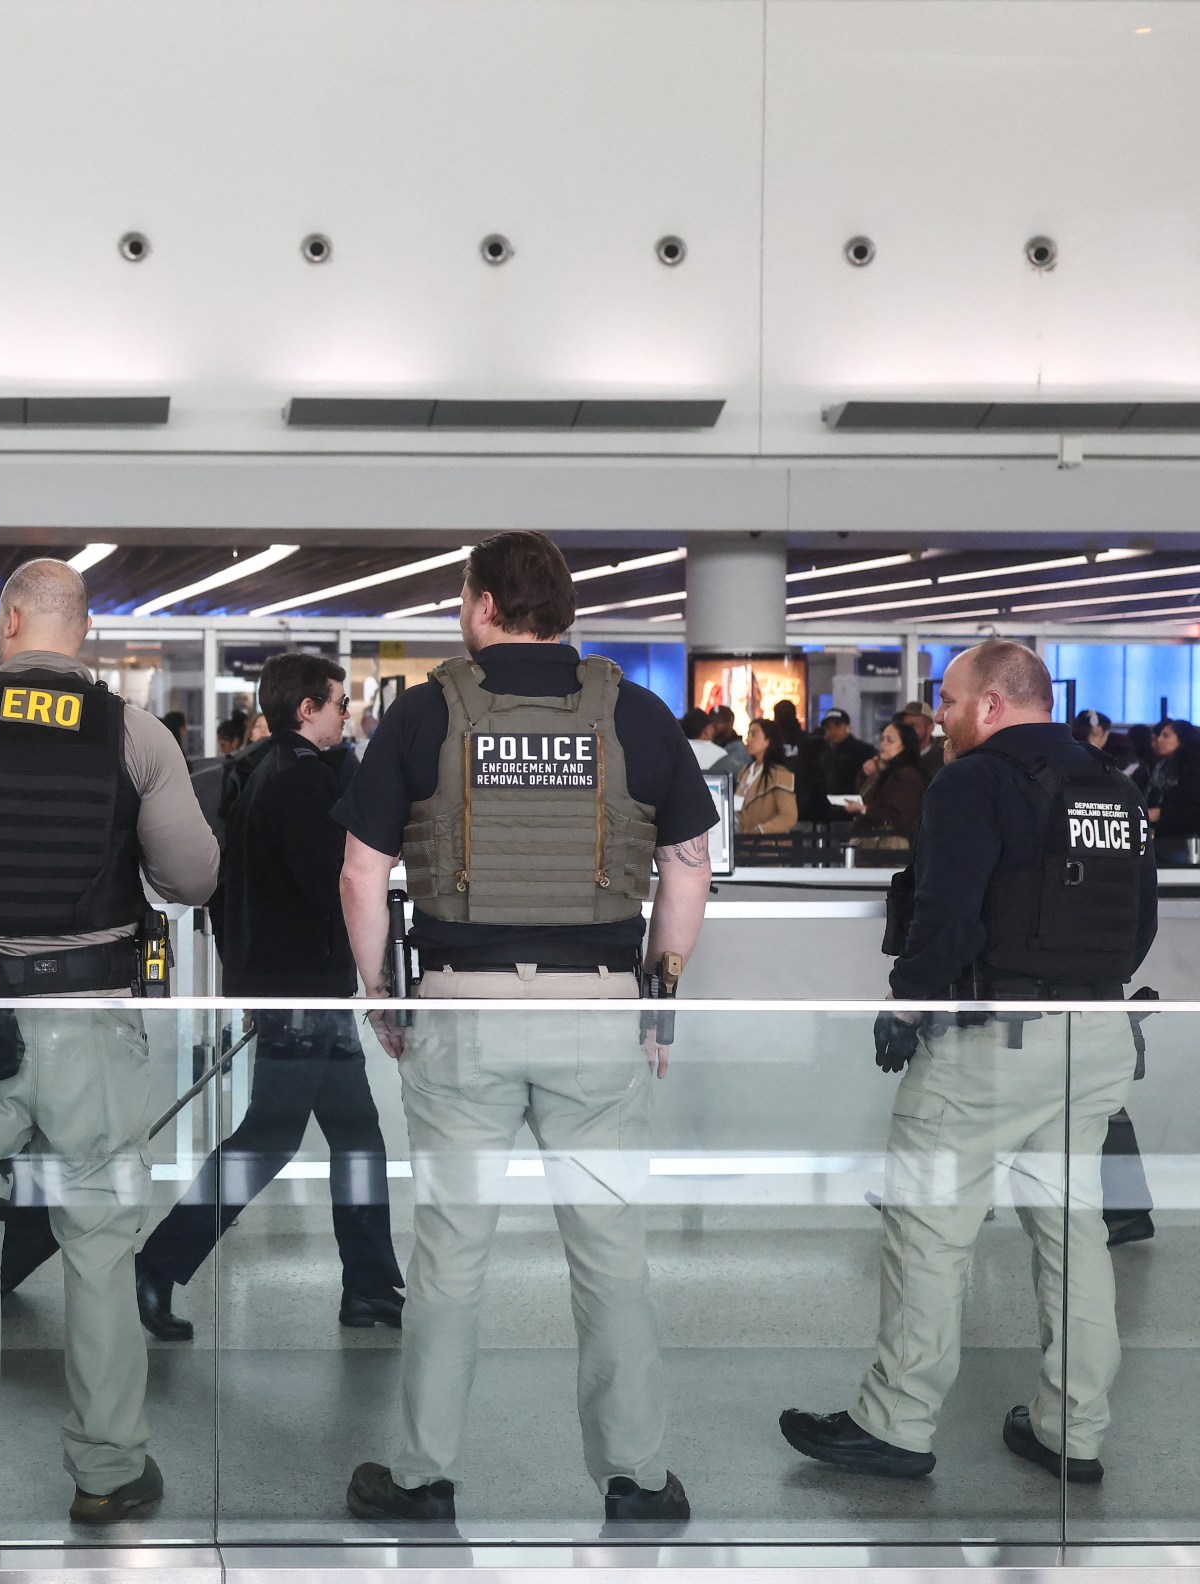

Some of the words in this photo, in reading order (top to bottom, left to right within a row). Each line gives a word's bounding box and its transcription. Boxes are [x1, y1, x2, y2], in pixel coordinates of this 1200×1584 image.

[2, 689, 81, 727] ERO
[477, 736, 592, 760] POLICE
[482, 762, 558, 773] ENFORCEMENT
[562, 763, 584, 773] AND
[477, 774, 525, 785] REMOVAL
[529, 775, 593, 785] OPERATIONS
[1074, 802, 1113, 811] DEPARTMENT
[1067, 808, 1101, 817] HOMELAND
[1101, 810, 1129, 819] SECURITY
[1069, 818, 1131, 850] POLICE
